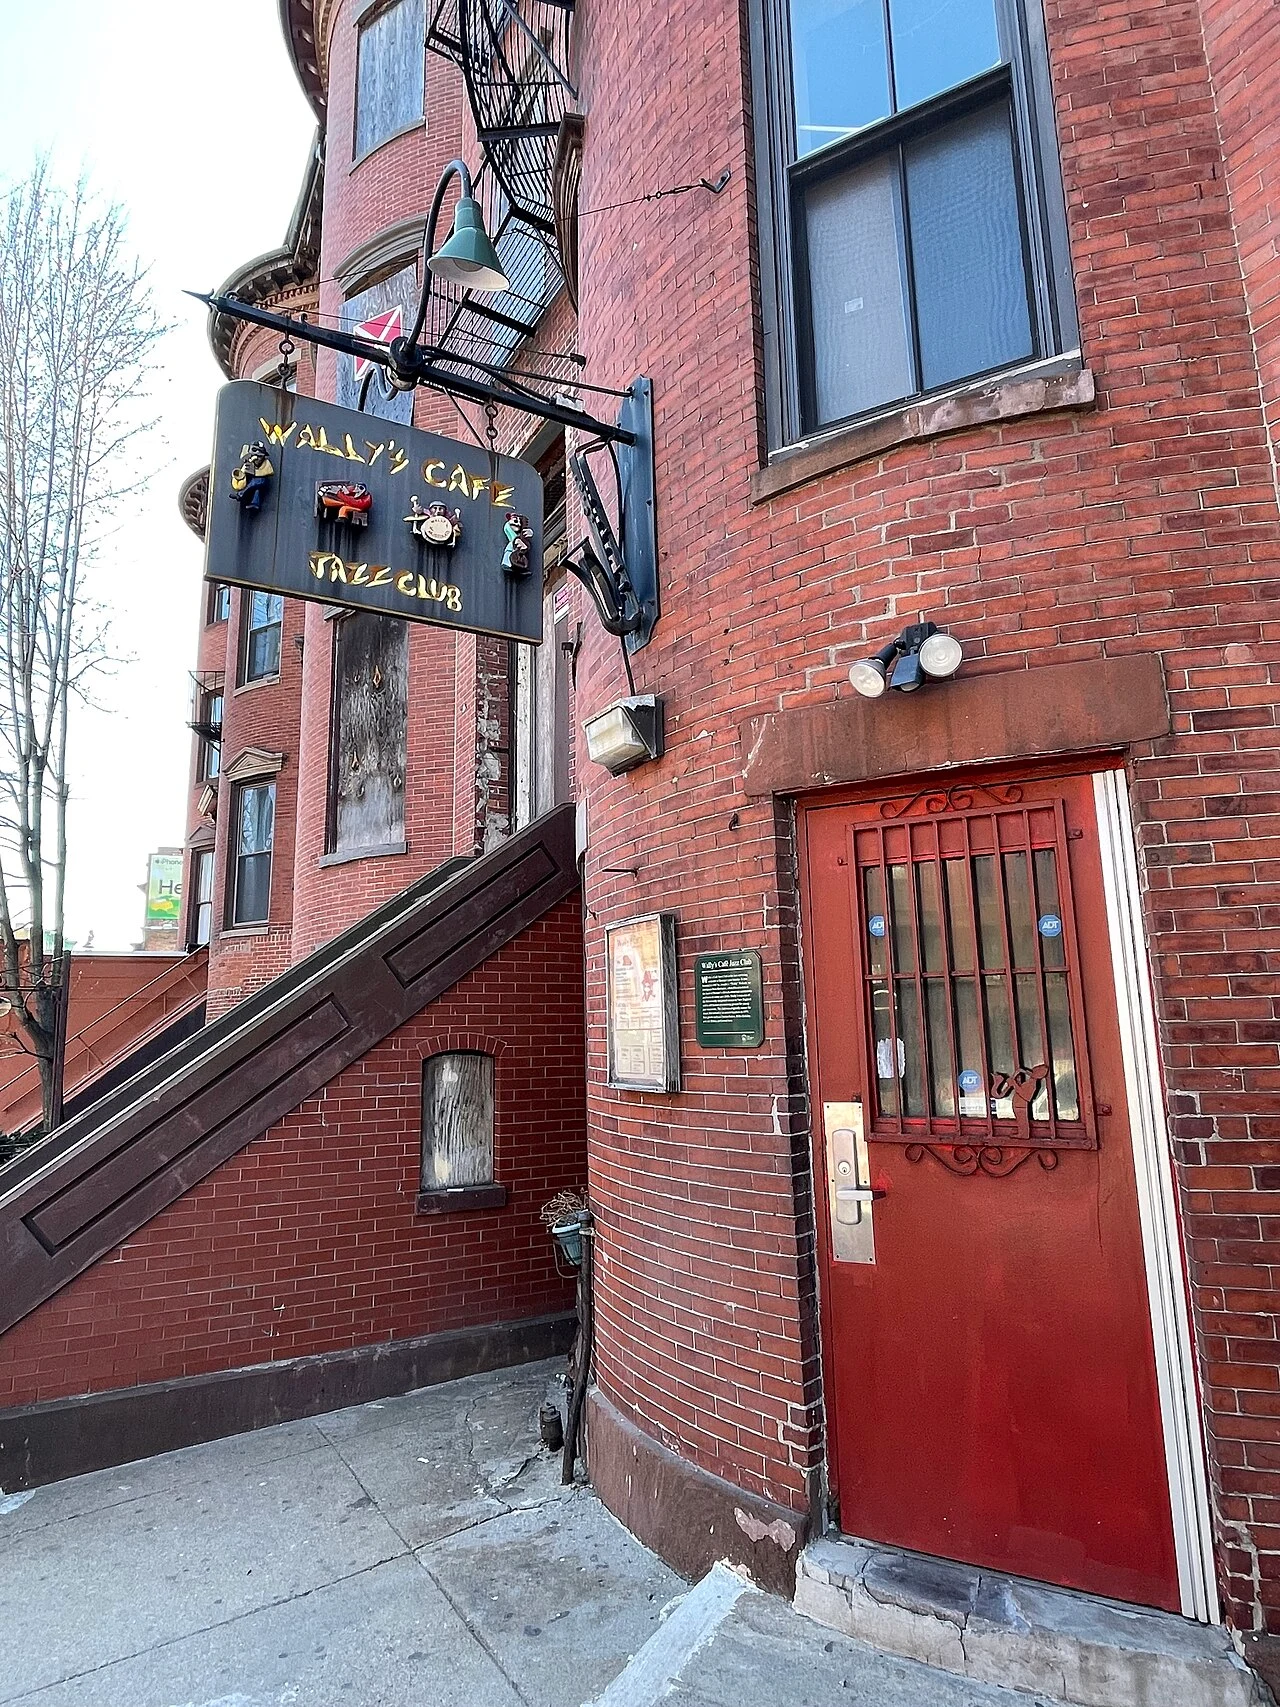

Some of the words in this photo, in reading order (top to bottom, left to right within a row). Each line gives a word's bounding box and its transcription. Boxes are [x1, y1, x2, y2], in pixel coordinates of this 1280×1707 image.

[258, 417, 409, 475] WALLY'S
[421, 458, 517, 510] CAFE
[308, 551, 394, 588] JAZZ
[395, 571, 463, 613] CLUB
[1041, 920, 1059, 929] ADT
[740, 958, 752, 966] Club
[962, 1075, 978, 1085] ADT
